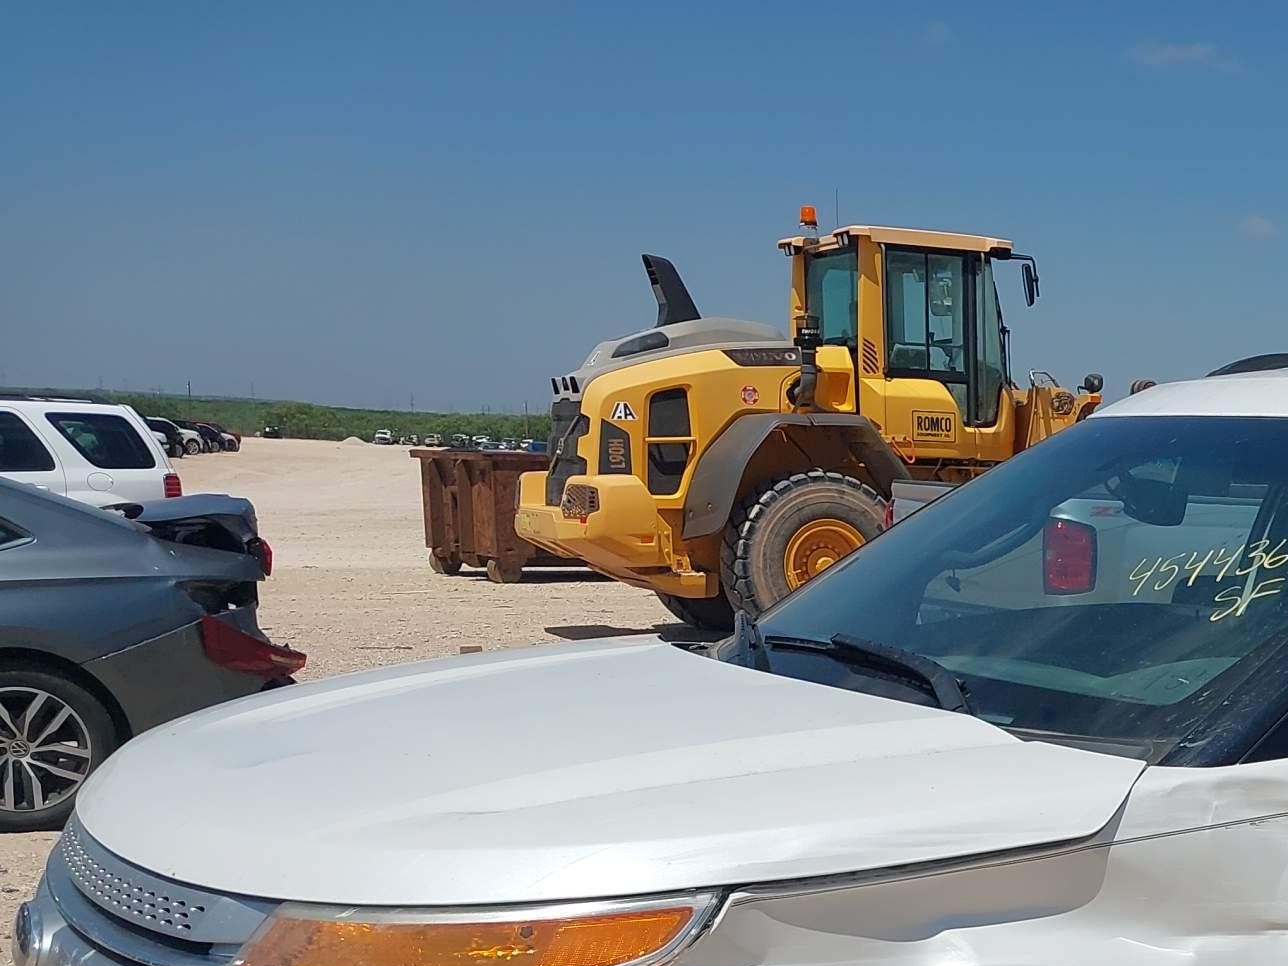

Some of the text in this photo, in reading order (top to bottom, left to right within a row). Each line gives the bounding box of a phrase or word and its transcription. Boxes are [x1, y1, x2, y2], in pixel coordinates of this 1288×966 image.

[916, 415, 952, 433] ROMCO
[607, 437, 626, 469] L90H
[1209, 577, 1286, 622] SF
